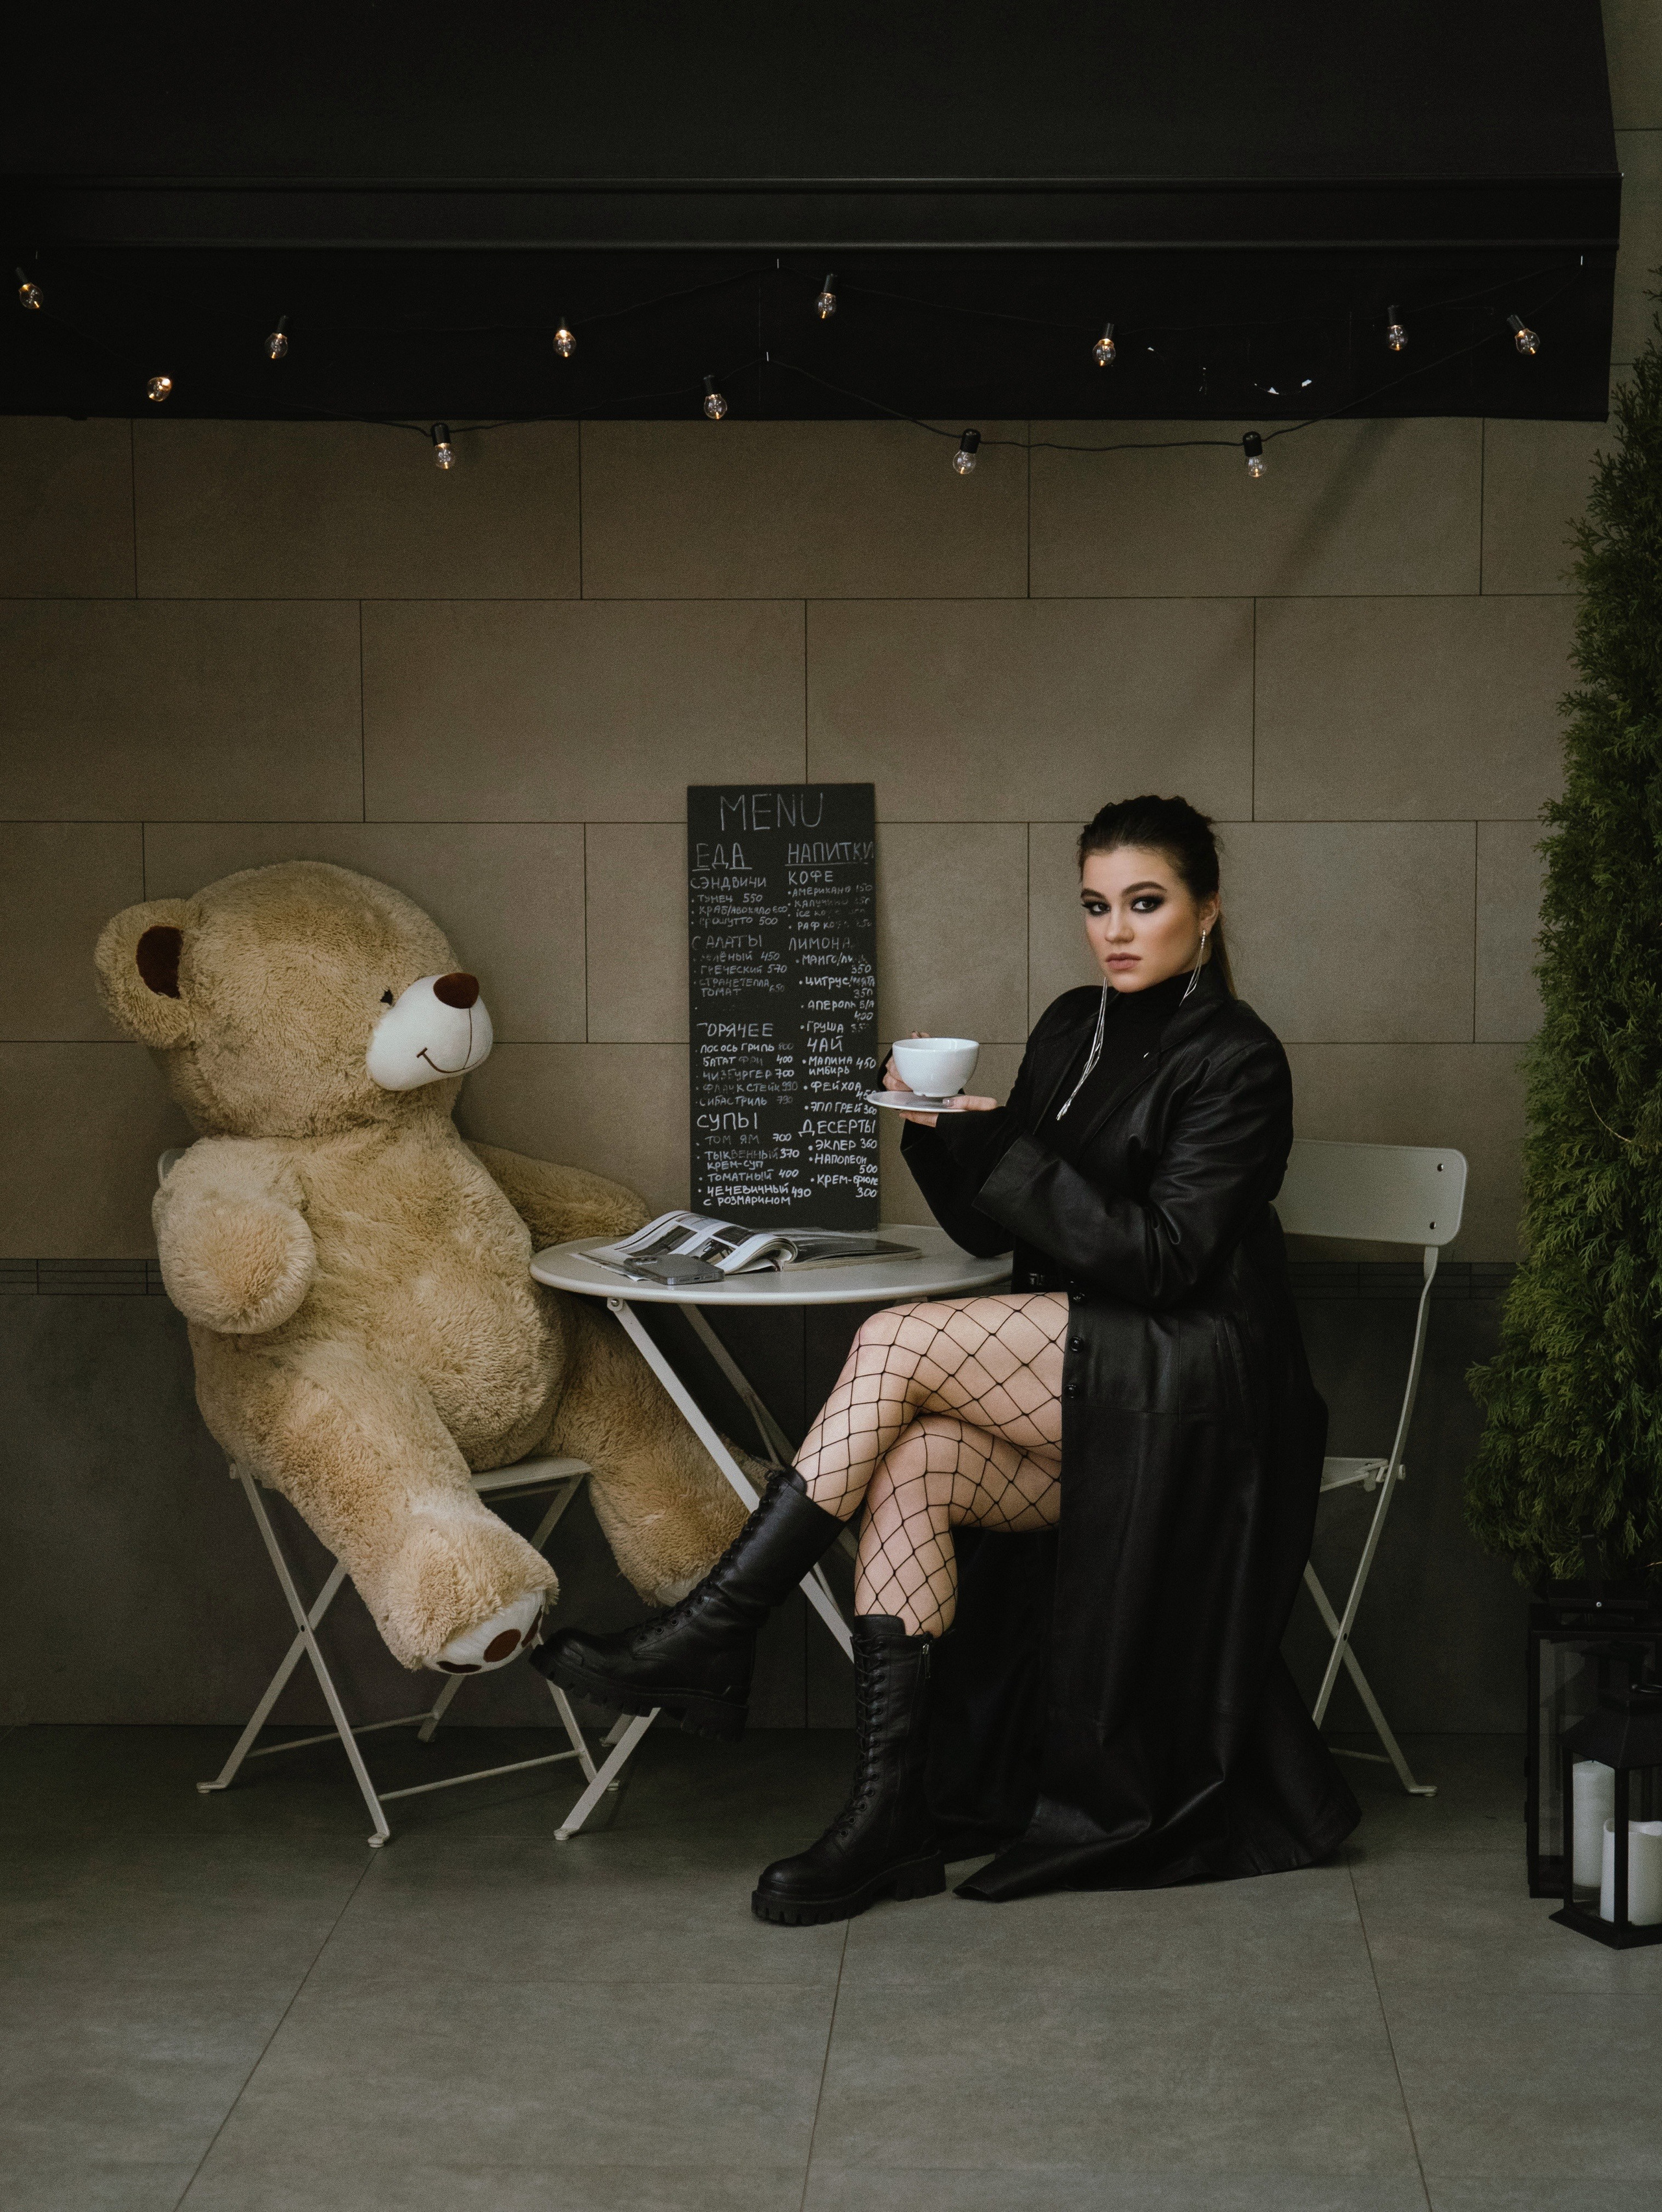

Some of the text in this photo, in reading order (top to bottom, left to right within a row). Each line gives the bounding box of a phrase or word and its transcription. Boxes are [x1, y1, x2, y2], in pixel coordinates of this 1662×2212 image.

[720, 792, 824, 832] MENU
[696, 842, 745, 869] ЕДА
[788, 841, 874, 864] НАПИТКИ
[690, 876, 767, 891] СЭНДВИЧИ
[788, 870, 834, 886] КОФЕ
[791, 885, 852, 898] АМЕРИКАНО
[697, 893, 763, 904] ТУНЕЦ 550
[759, 916, 778, 926] 500
[797, 921, 821, 931] РАФ
[691, 934, 762, 951] САЛАТЫ
[760, 951, 780, 962] 450
[701, 963, 788, 975] ГРЕЧЕСКИЙ 570
[701, 988, 741, 997] ТОМАТ
[853, 988, 873, 999] 350
[806, 1020, 844, 1034] ГРУША
[700, 1044, 738, 1054] ЛОСОСЬ
[741, 1042, 775, 1052] ГРИЛЬ
[807, 1035, 843, 1053] ЧАЙ
[702, 1054, 794, 1067] БАТАТ ФРИ 400
[808, 1055, 876, 1070] МАЛИНА 450
[775, 1068, 795, 1079] 700
[809, 1065, 850, 1078] ИМБИРЬ
[746, 1082, 780, 1093] СТЕЙК
[810, 1080, 862, 1093] ФЕЙХОА
[834, 1102, 864, 1113] ГРЕЙ
[697, 1112, 758, 1132] СУПЫ
[798, 1119, 876, 1137] ДЕСЕРТЫ
[704, 1133, 792, 1145] ТОМ ЯМ 700
[815, 1137, 878, 1150] ЭКЛЕР 360
[704, 1147, 800, 1160] ТЫКВЕННЫЙ 370
[814, 1153, 867, 1166] НАПОЛЕОН
[707, 1160, 763, 1172] КРЕМ-СУП
[859, 1163, 878, 1174] 500
[707, 1168, 800, 1183] ТОМАТНЫЙ 400
[817, 1174, 878, 1189] КРЕМ-БРЮЛЕ
[707, 1182, 812, 1199] ЧЕЧЕВИЧНЫЙ 490
[855, 1186, 878, 1199] 300
[717, 1195, 791, 1208] РОЗМАРИНОМ
